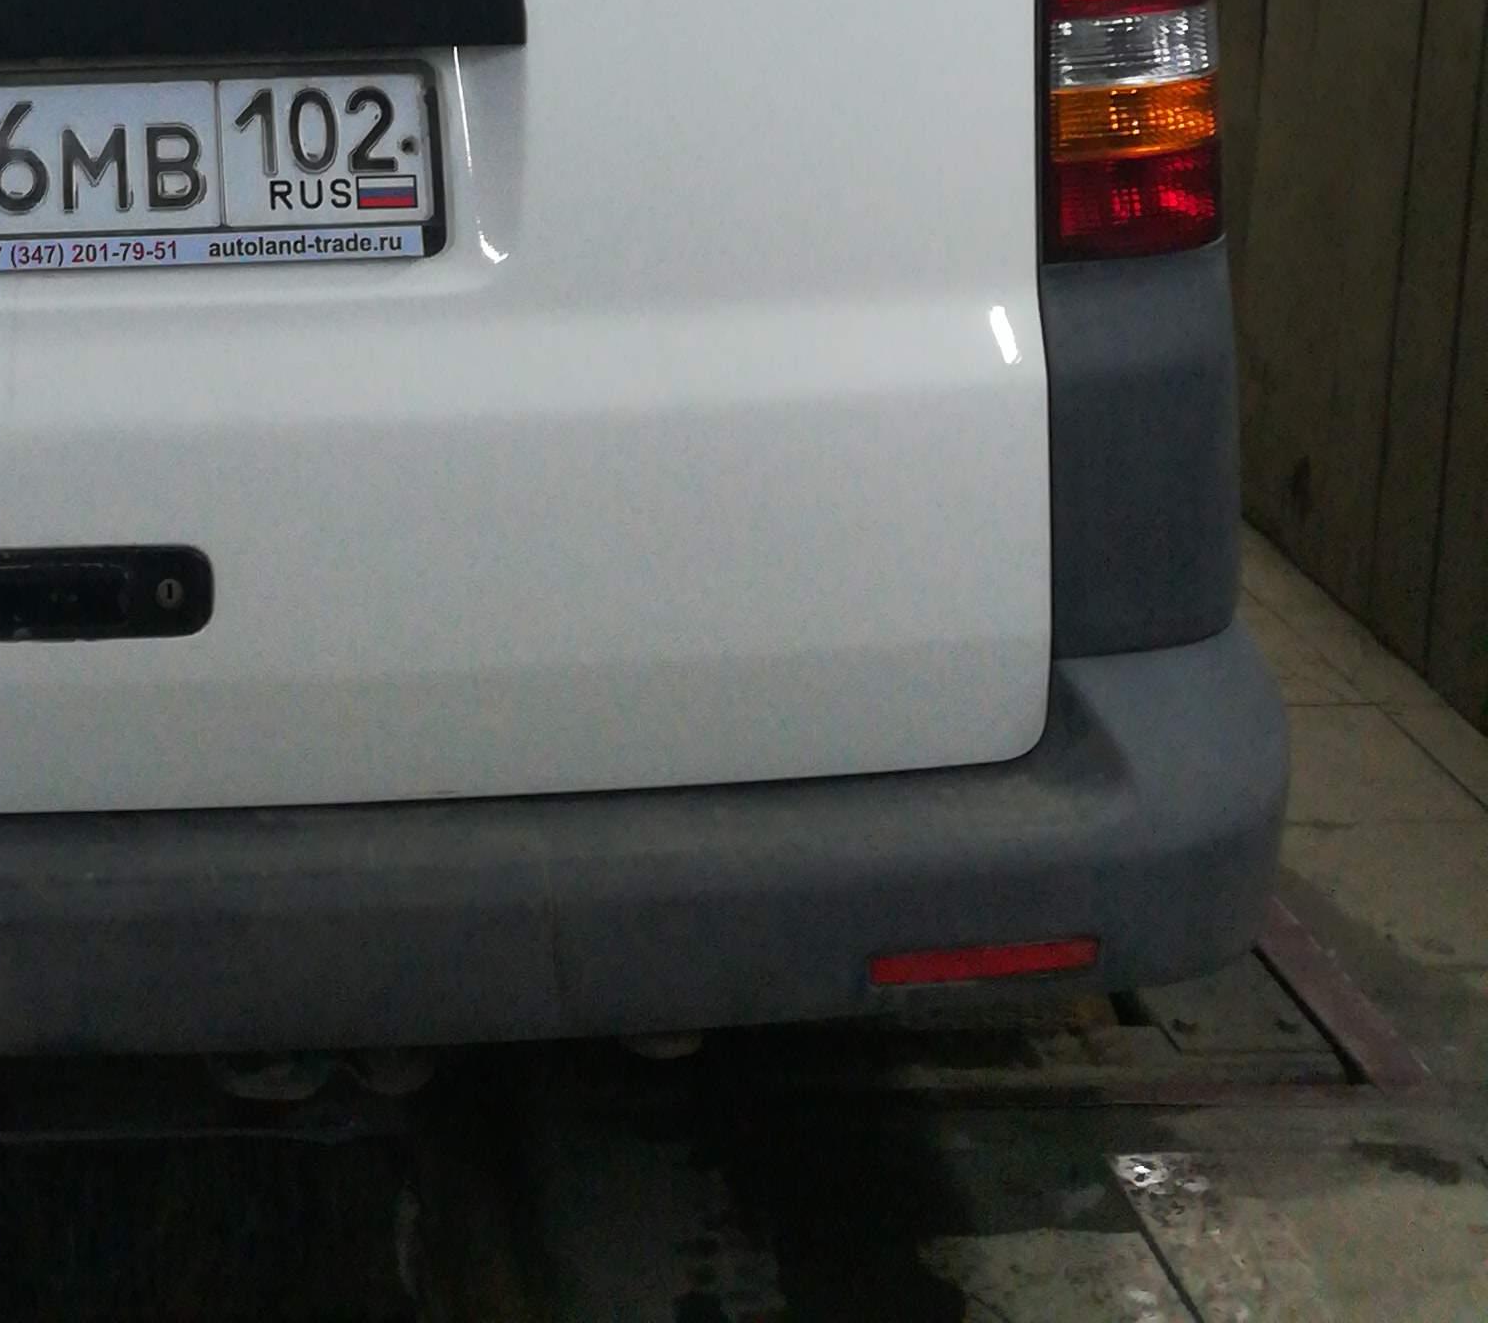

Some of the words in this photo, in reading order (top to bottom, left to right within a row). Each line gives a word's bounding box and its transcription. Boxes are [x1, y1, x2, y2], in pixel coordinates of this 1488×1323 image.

[234, 87, 400, 176] 102
[268, 177, 354, 211] RUS
[10, 243, 65, 270] (347)
[71, 240, 179, 264] 201-79-51
[208, 234, 402, 258] autoland-trade.ru
